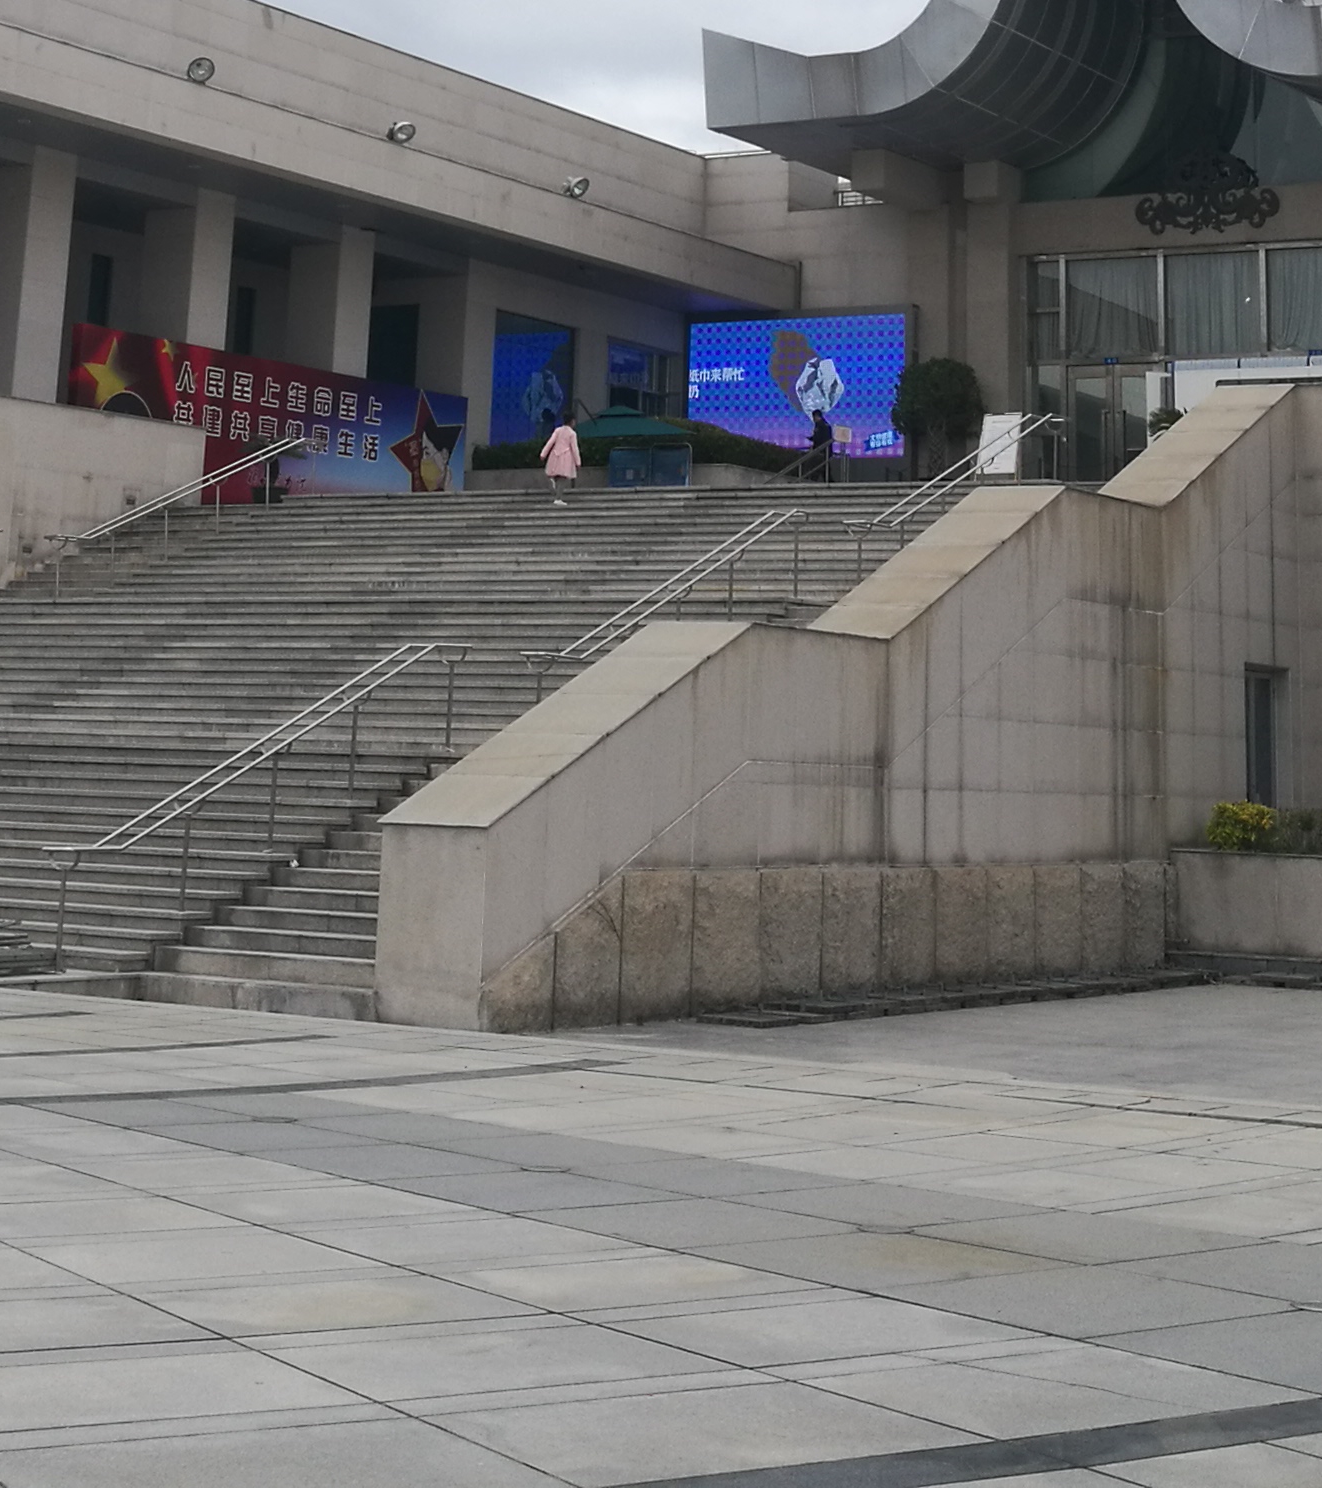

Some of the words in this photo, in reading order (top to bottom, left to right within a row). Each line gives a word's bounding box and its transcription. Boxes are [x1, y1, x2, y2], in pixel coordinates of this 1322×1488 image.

[175, 361, 383, 427] 人民至上生命至上
